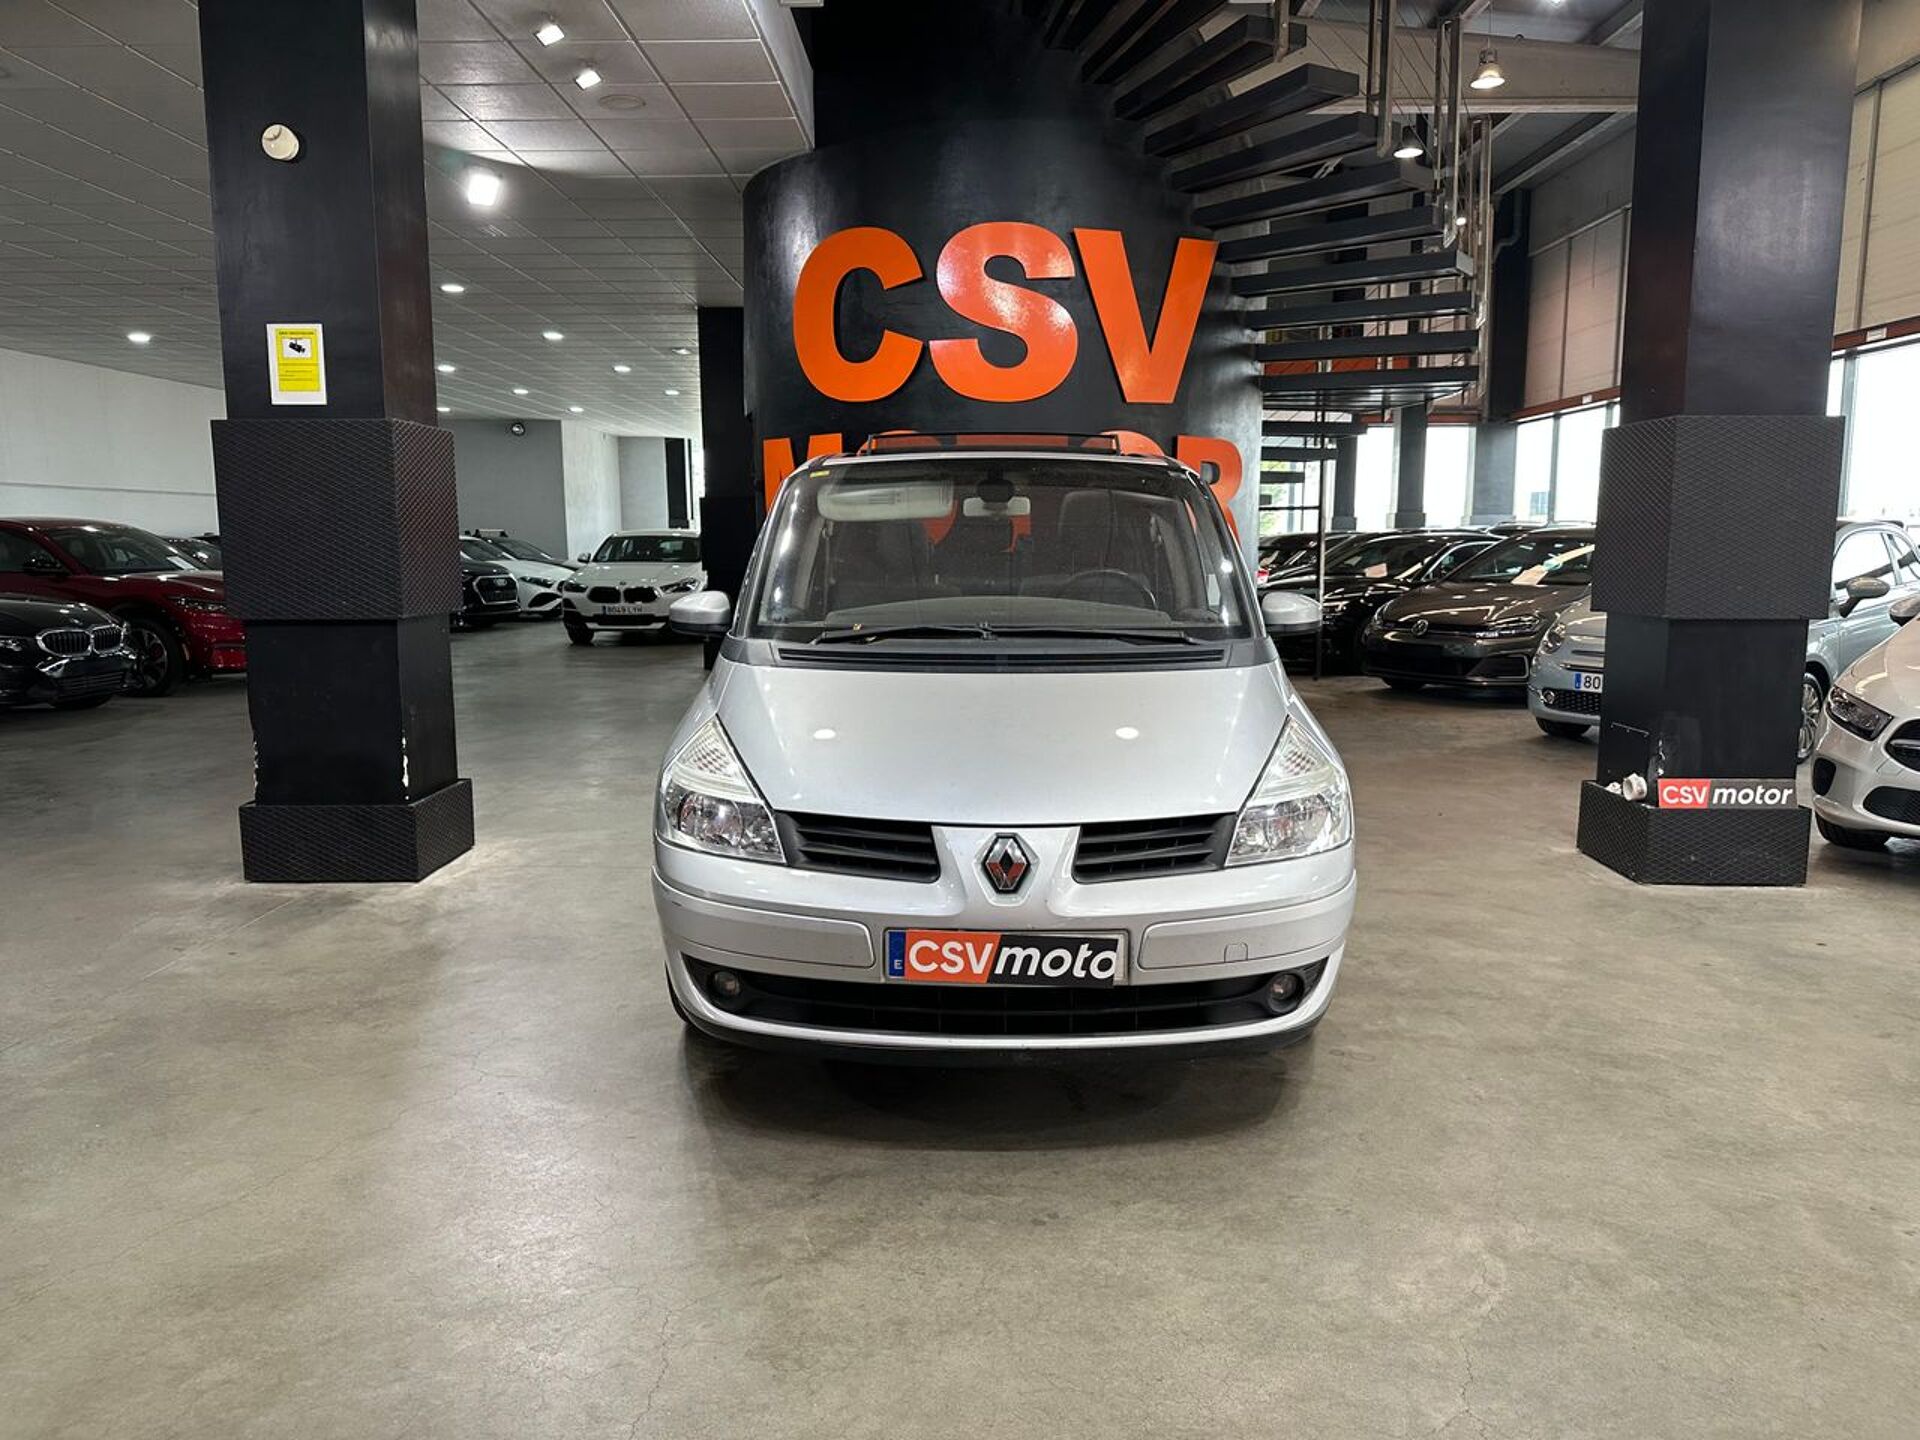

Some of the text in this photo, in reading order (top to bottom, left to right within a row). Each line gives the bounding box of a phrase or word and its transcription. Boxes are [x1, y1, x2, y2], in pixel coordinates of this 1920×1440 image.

[793, 221, 1219, 403] CSV
[1662, 785, 1794, 805] CSV motor
[894, 959, 903, 970] E
